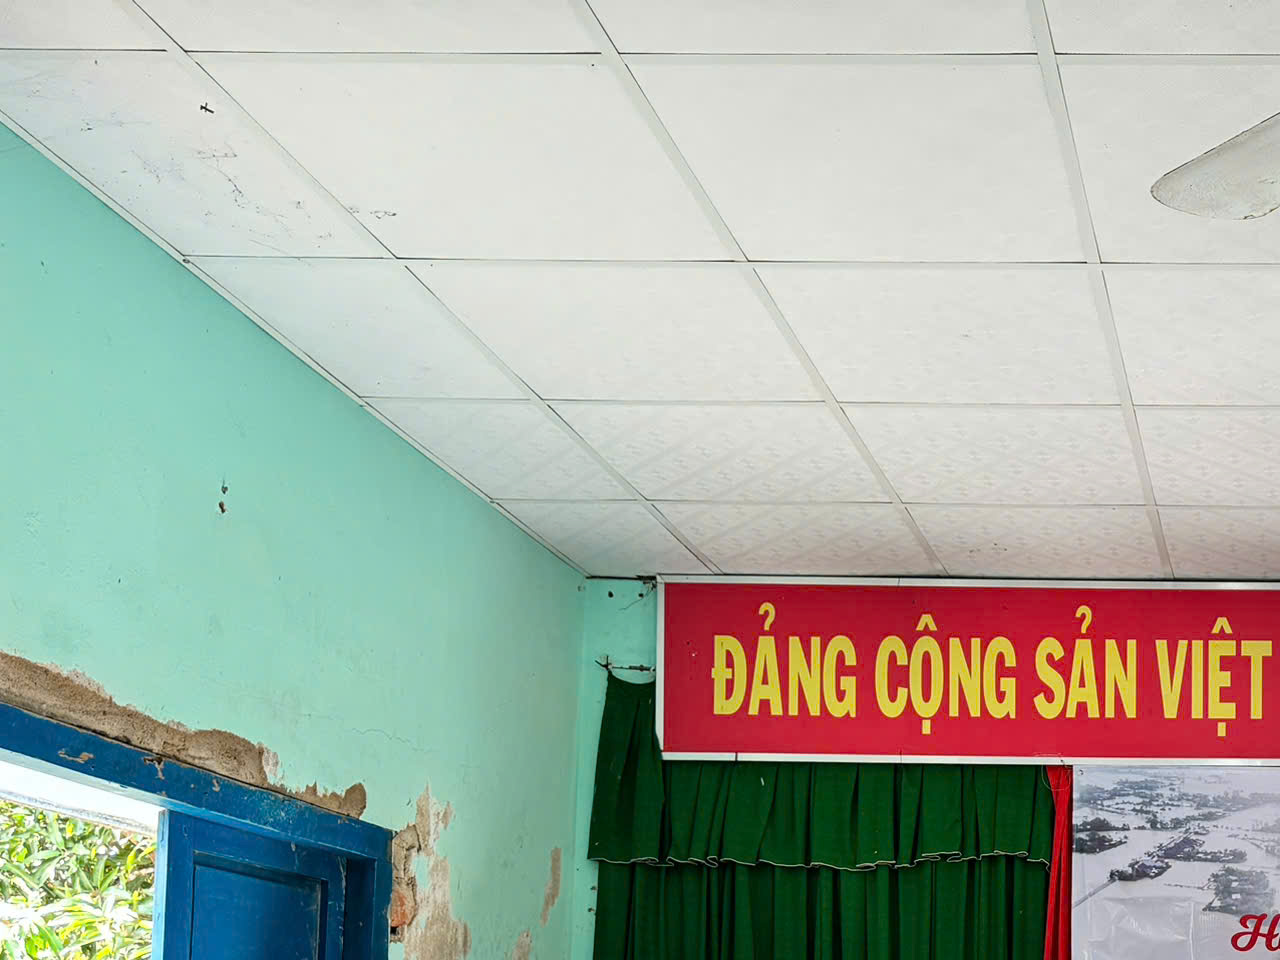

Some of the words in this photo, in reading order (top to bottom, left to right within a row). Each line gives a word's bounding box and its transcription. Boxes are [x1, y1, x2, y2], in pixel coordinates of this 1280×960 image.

[711, 603, 857, 718] ĐẢNG
[876, 614, 1017, 734] CỘNG
[1035, 606, 1137, 719] SẢN
[1156, 617, 1273, 737] VIỆT
